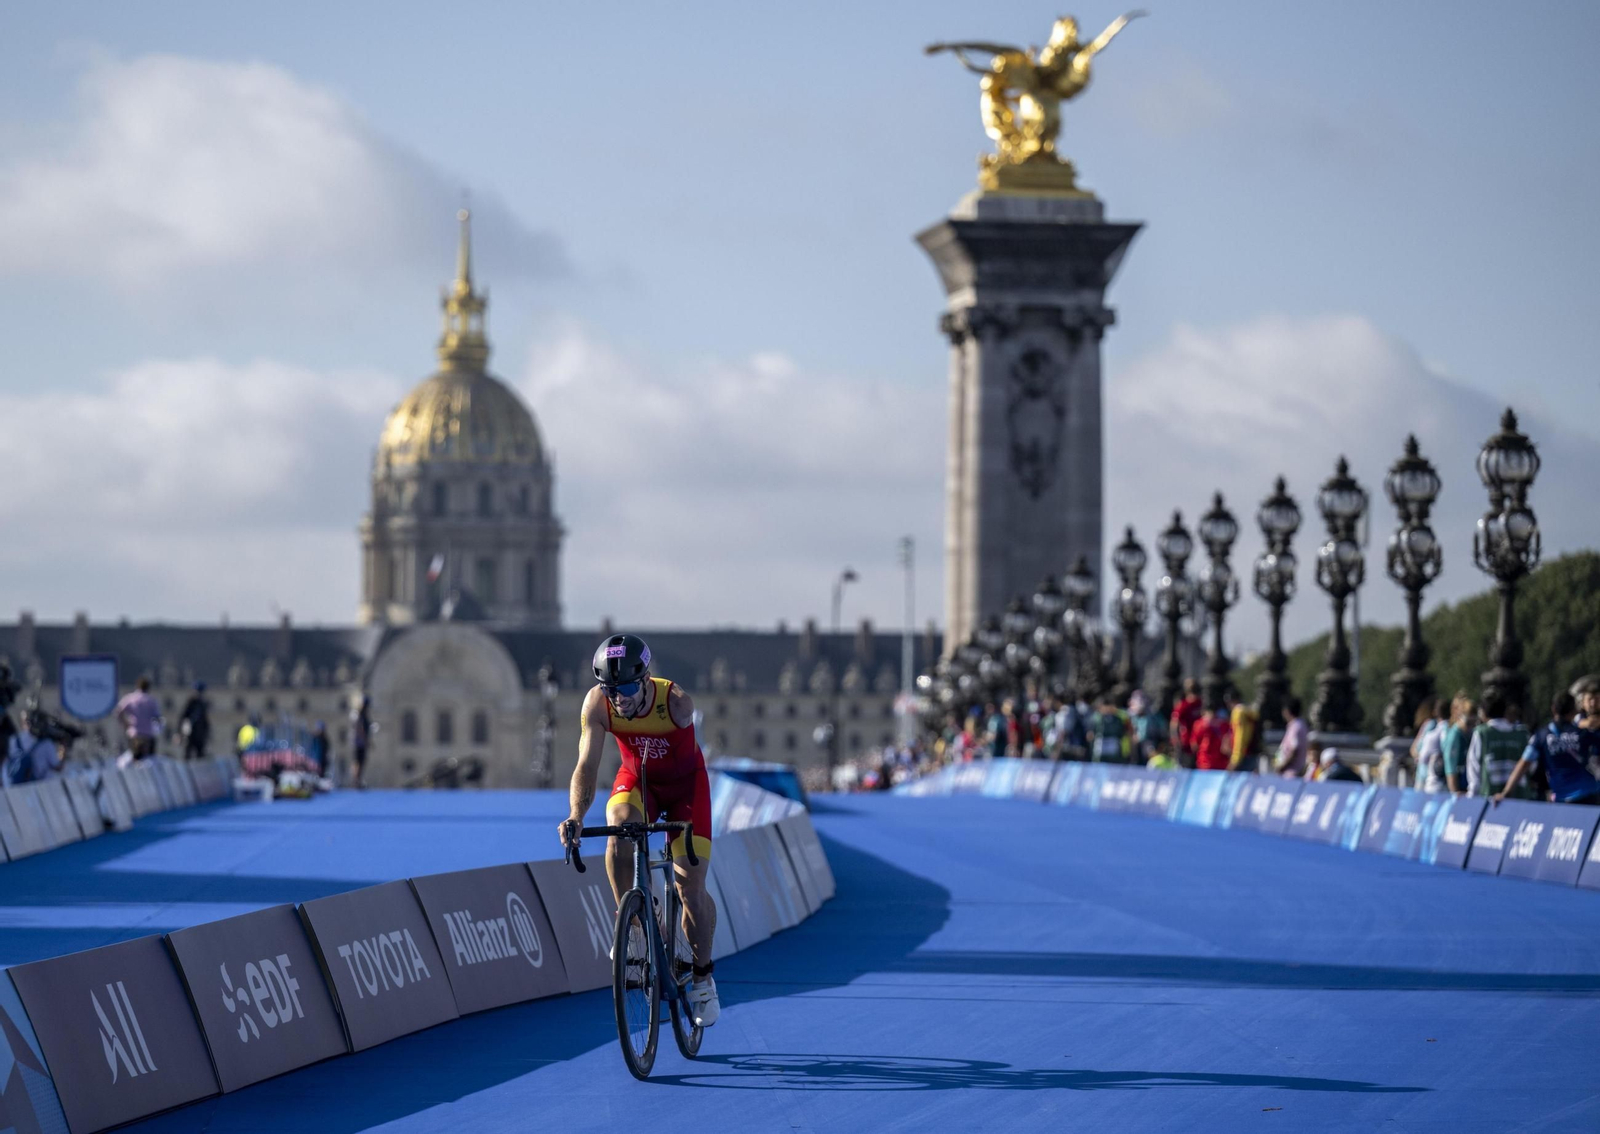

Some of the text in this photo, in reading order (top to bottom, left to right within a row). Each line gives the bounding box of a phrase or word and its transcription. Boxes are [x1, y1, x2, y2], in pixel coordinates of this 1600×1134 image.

[638, 746, 668, 759] ESP
[337, 928, 431, 999] TOYOTA
[442, 909, 518, 967] Allianz
